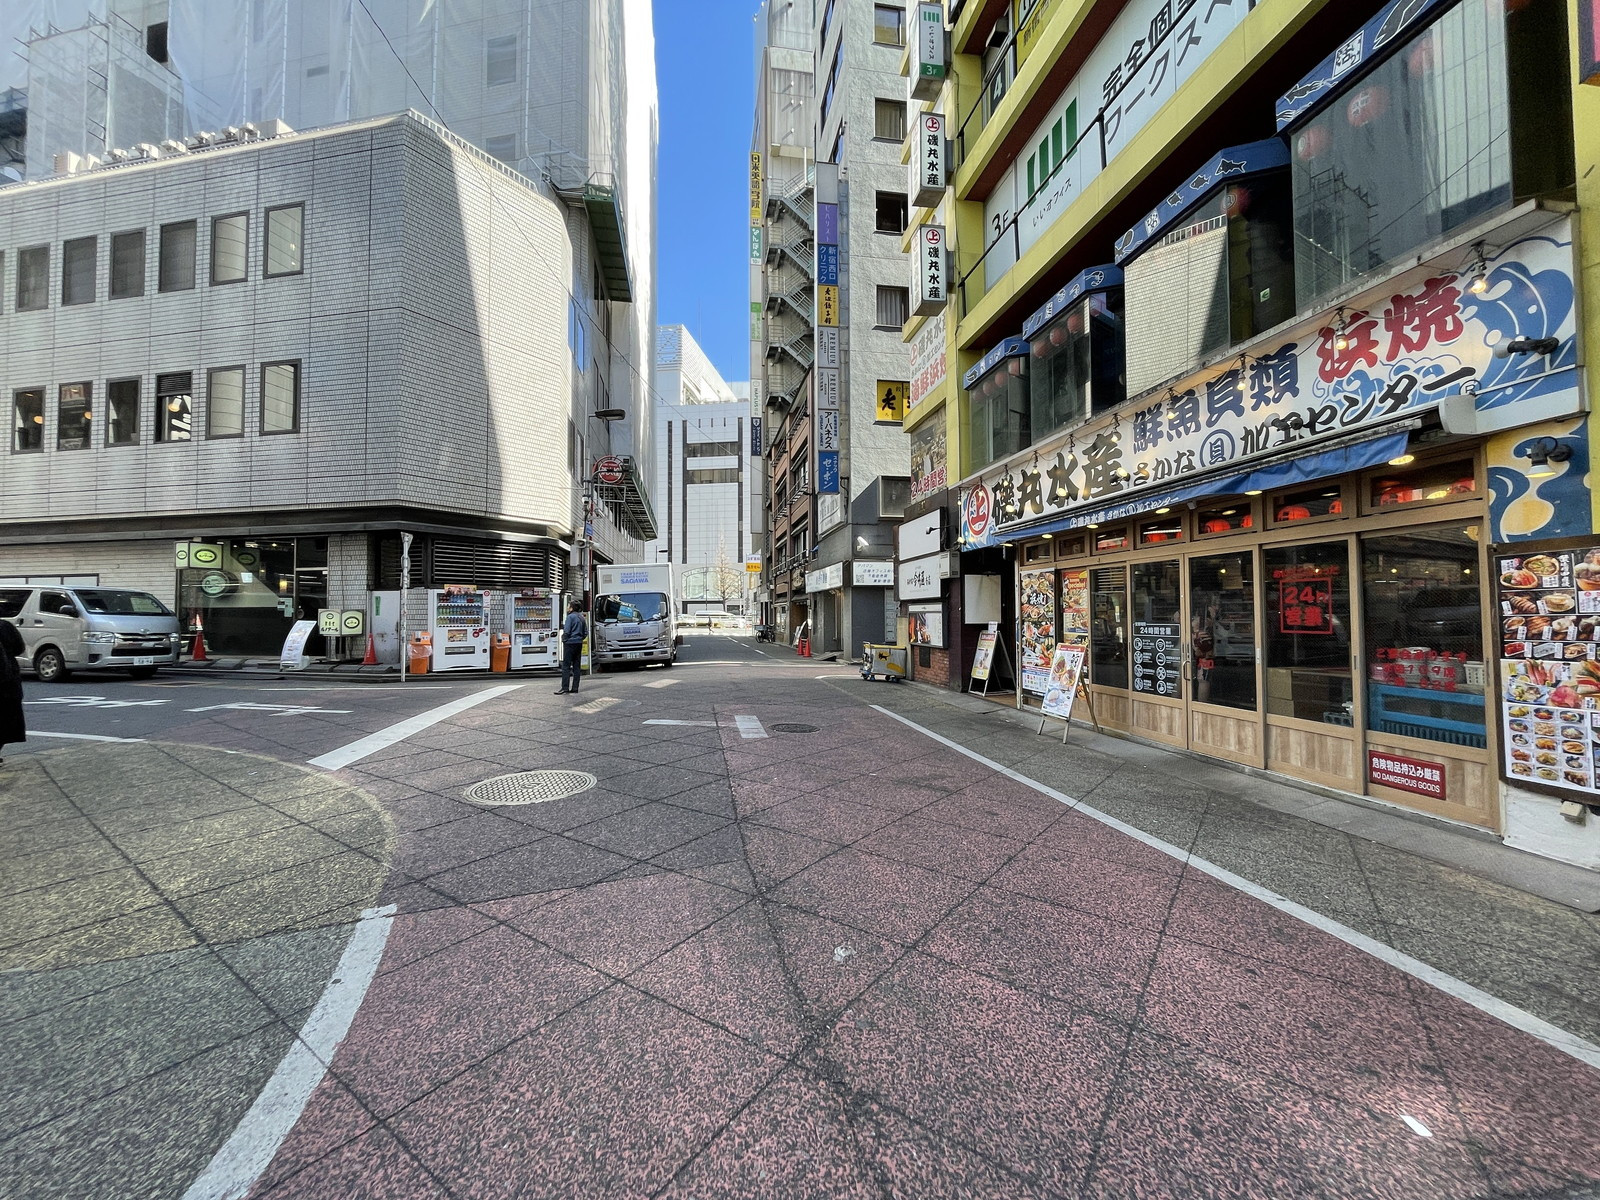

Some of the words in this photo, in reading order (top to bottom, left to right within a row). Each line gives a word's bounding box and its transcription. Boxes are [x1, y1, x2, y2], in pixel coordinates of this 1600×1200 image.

[926, 66, 938, 76] 3F
[927, 134, 939, 186] 磯丸水産
[828, 246, 837, 280] 新宿西口
[927, 247, 940, 299] 磯丸水産
[1317, 275, 1464, 384] 浜焼
[1132, 342, 1300, 455] 鮮魚貝類
[992, 432, 1123, 528] 磯丸水産
[1372, 757, 1440, 782] 危険物品持込み厳禁
[1372, 771, 1381, 779] NO
[1382, 773, 1417, 788] DANGEROUS
[1418, 781, 1441, 793] GOODS
